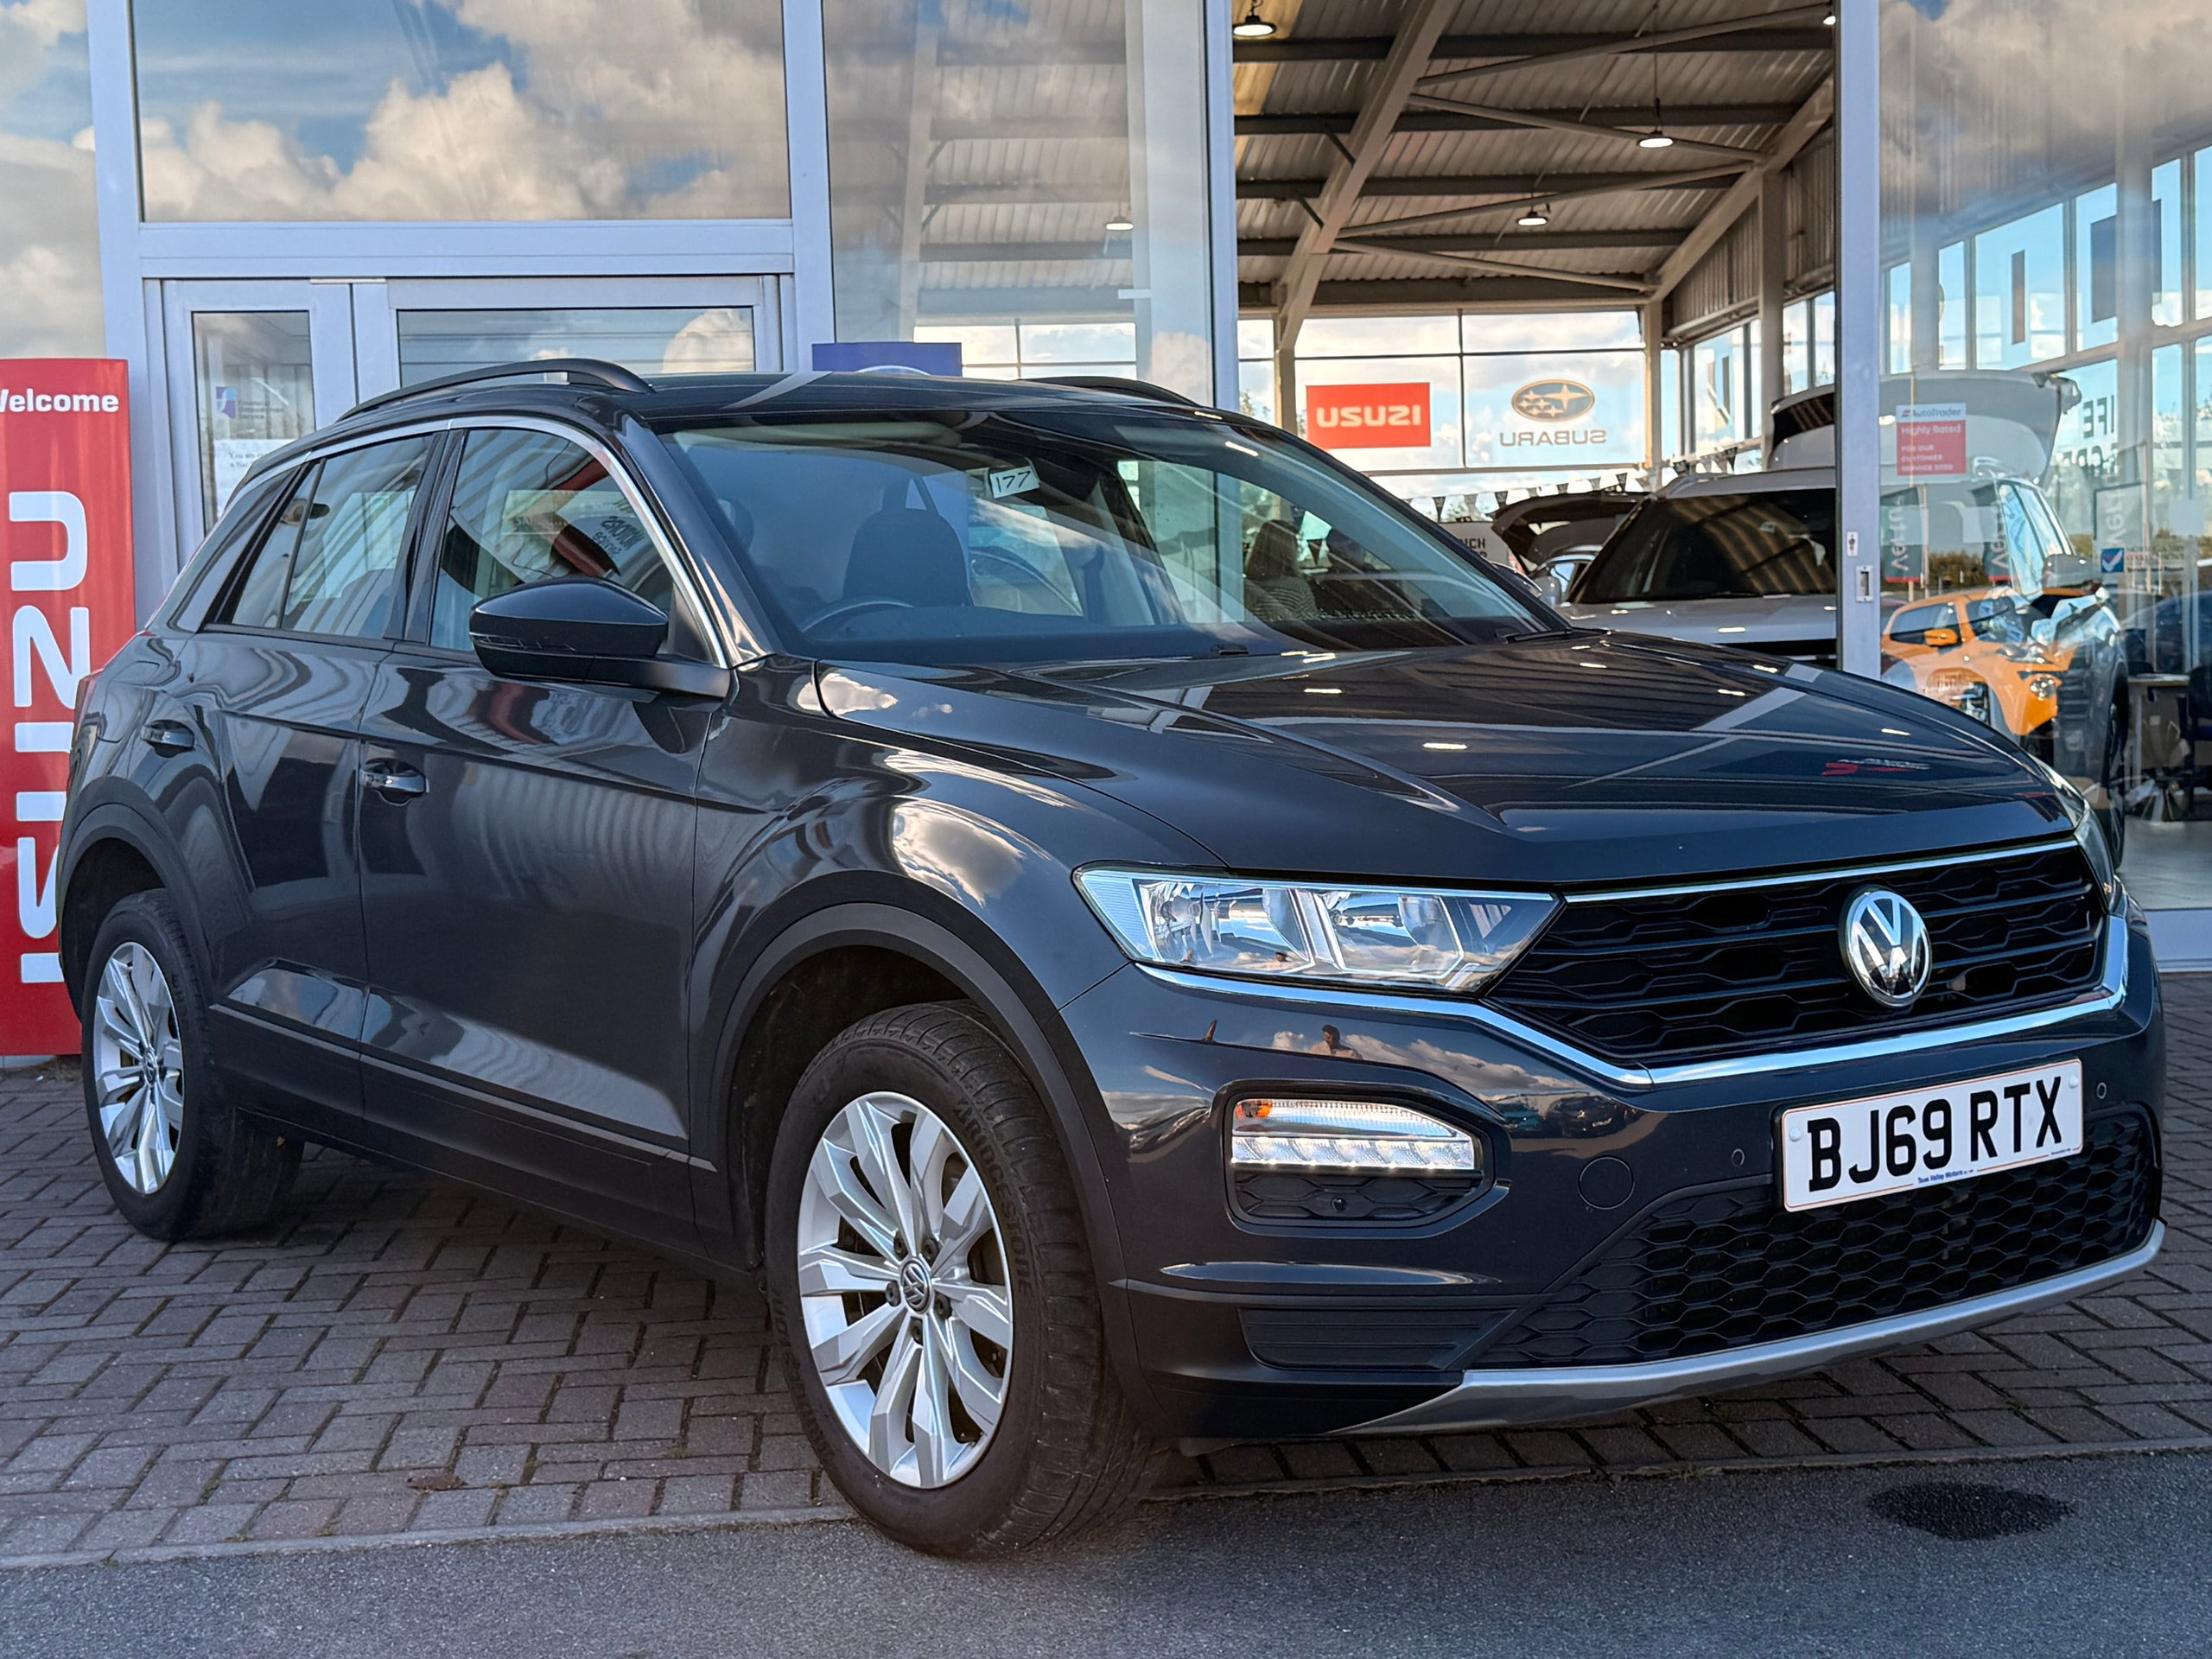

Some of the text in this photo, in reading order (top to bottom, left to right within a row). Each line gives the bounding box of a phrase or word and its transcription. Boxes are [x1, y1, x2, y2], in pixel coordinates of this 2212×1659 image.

[996, 470, 1031, 493] 177
[1807, 1076, 2062, 1192] BJ69 RTX
